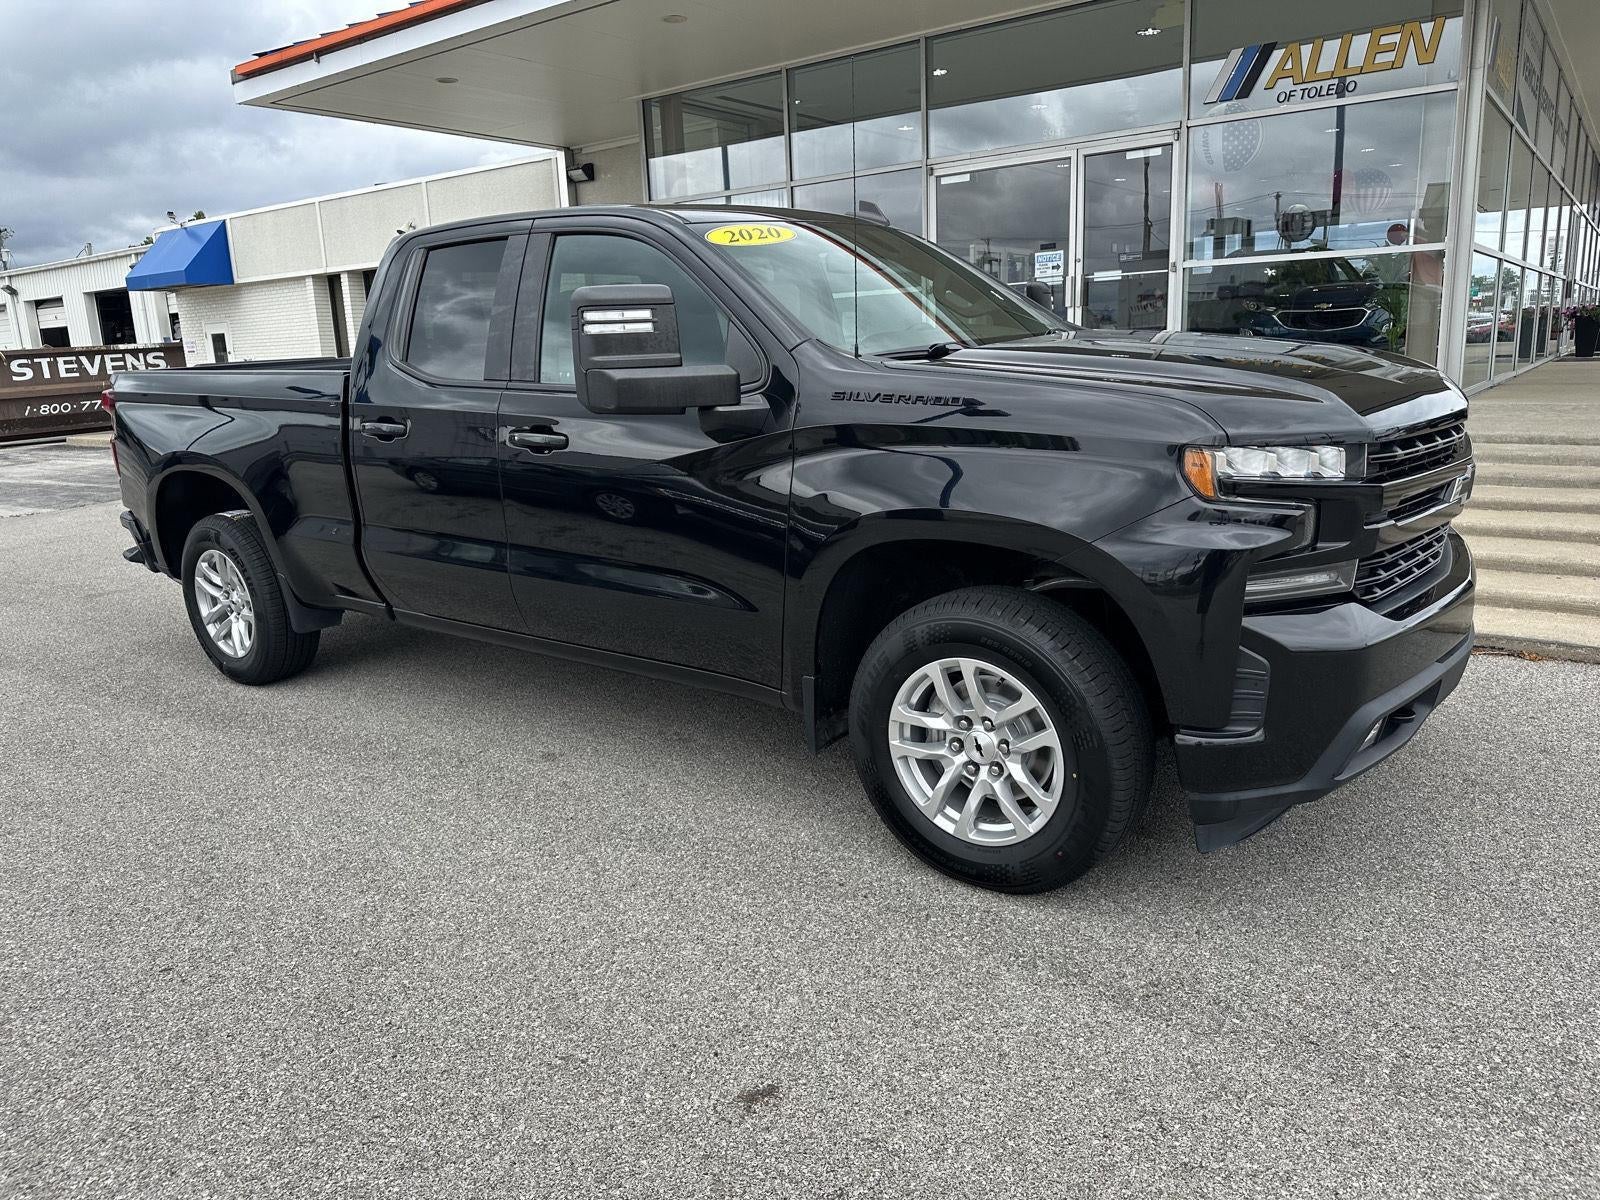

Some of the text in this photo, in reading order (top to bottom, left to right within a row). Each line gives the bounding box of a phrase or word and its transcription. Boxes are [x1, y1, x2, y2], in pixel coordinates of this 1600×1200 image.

[1264, 16, 1446, 90] ALLEN
[1276, 80, 1358, 103] OF TOLEDO
[724, 227, 781, 243] 2020
[1037, 254, 1061, 262] NOTICE
[9, 352, 167, 381] STEVENS
[830, 391, 965, 407] SILVERADO
